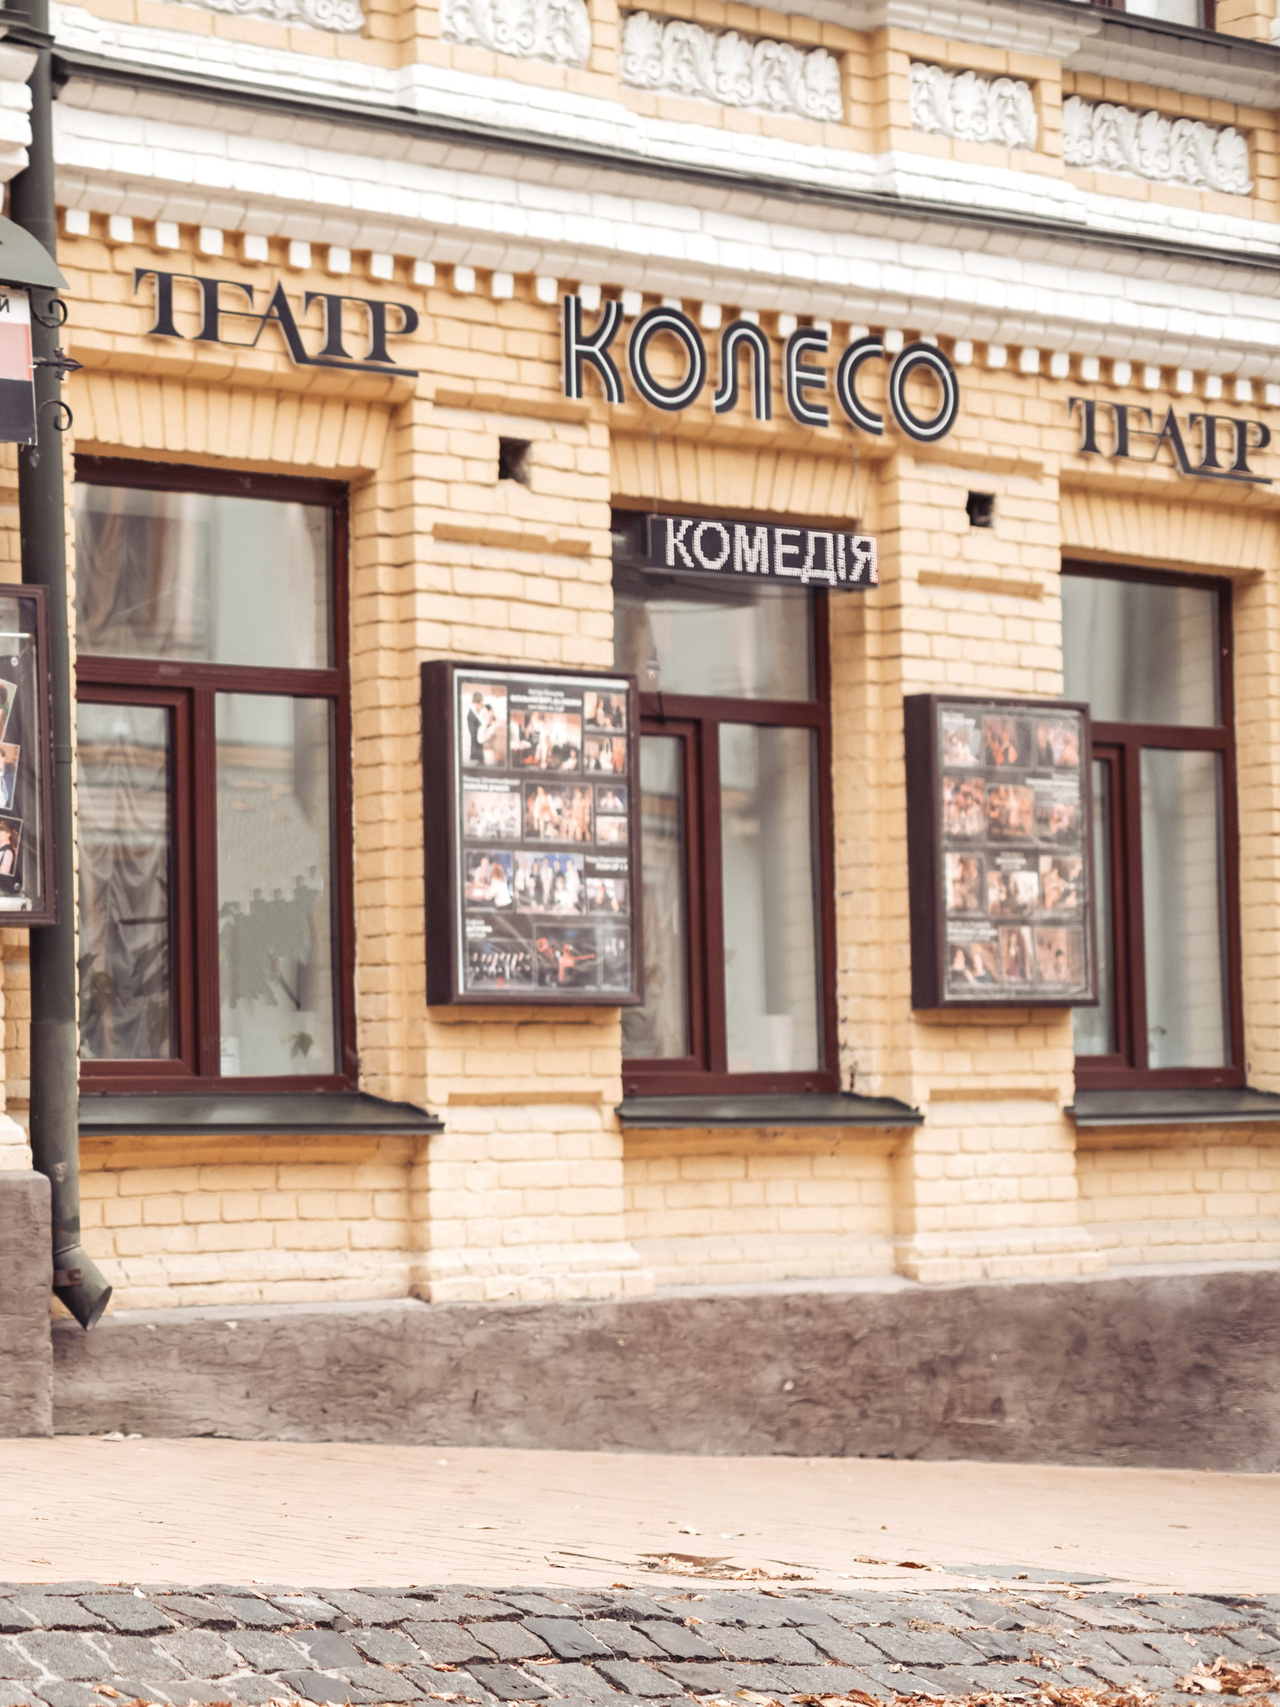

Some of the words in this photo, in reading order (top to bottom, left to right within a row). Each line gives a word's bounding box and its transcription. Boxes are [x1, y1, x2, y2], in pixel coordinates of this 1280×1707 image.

[133, 268, 420, 377] ТЕАТР
[564, 294, 960, 443] КОЛЕСО
[1068, 396, 1273, 484] ТЕАТР
[665, 517, 880, 586] КОМЕДІЯ
